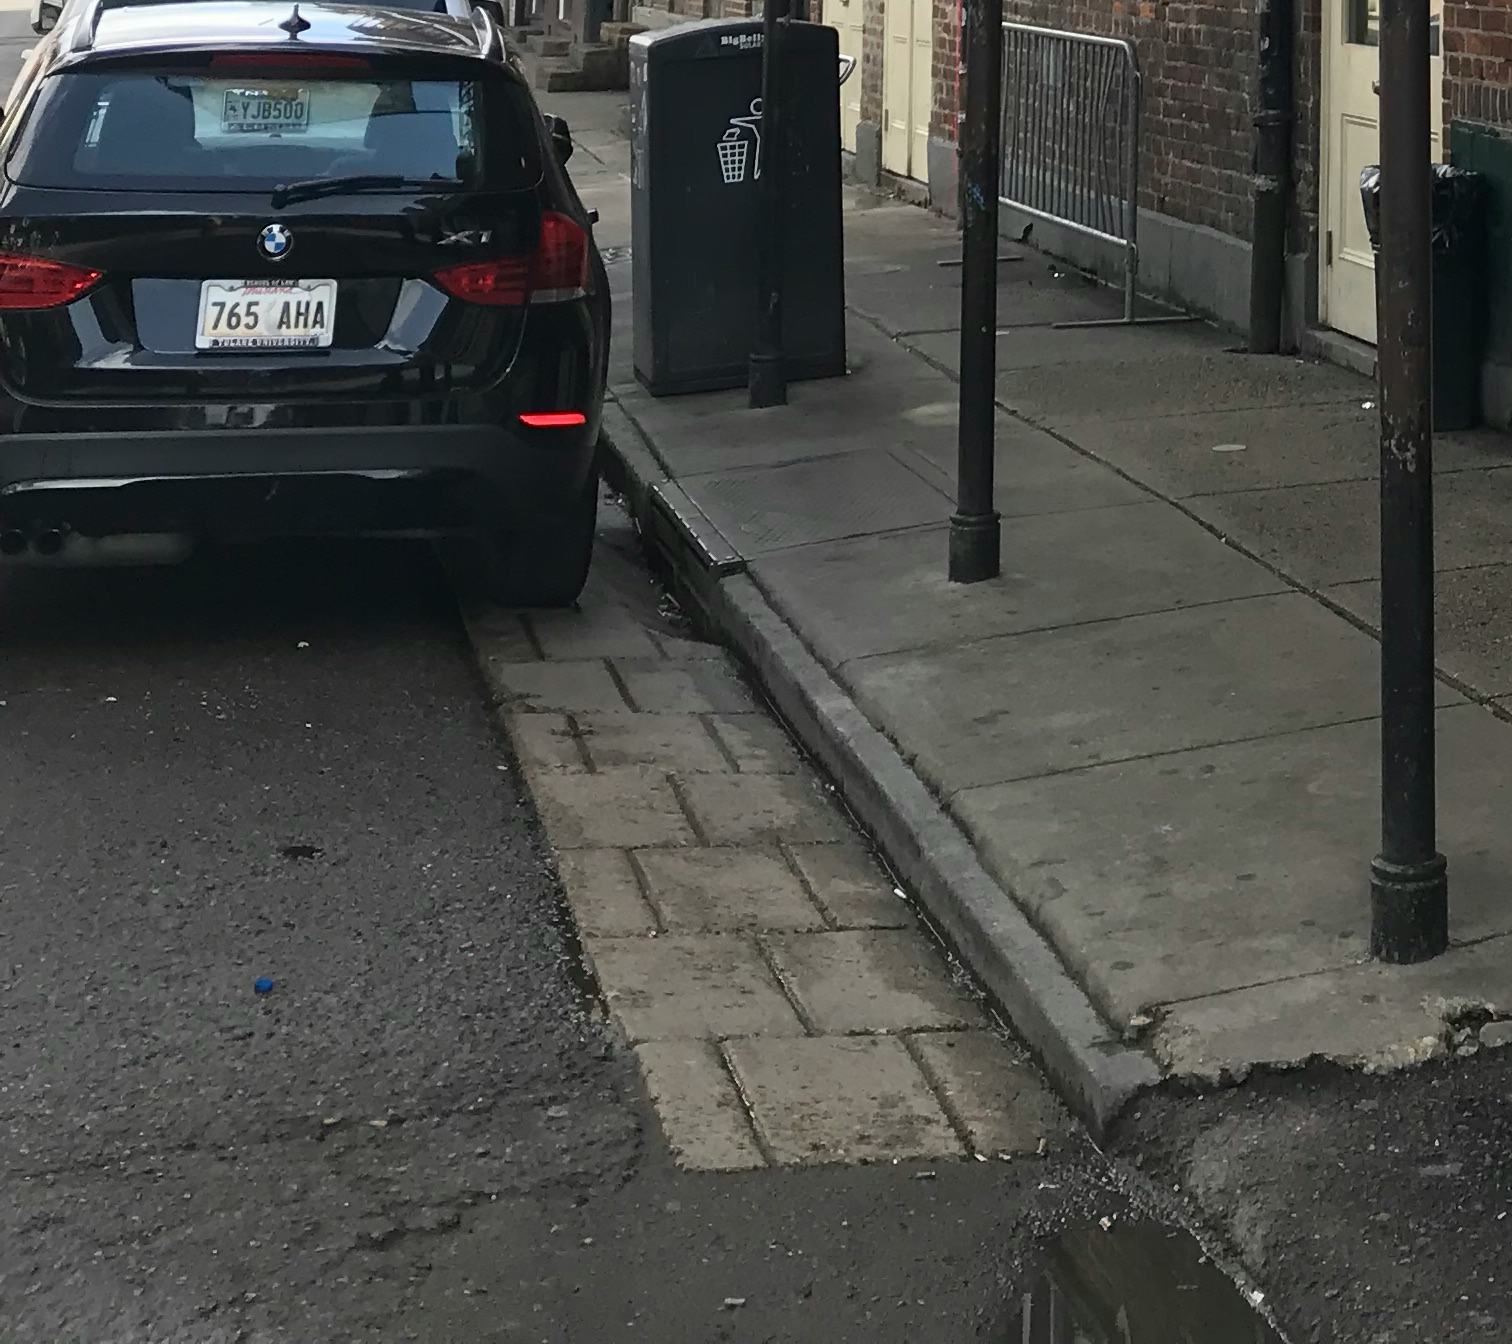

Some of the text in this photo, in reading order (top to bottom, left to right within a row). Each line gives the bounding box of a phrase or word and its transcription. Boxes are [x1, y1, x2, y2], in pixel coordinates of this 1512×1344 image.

[241, 101, 304, 120] YJB500
[437, 230, 492, 245] X1
[211, 300, 325, 330] 765 AHA
